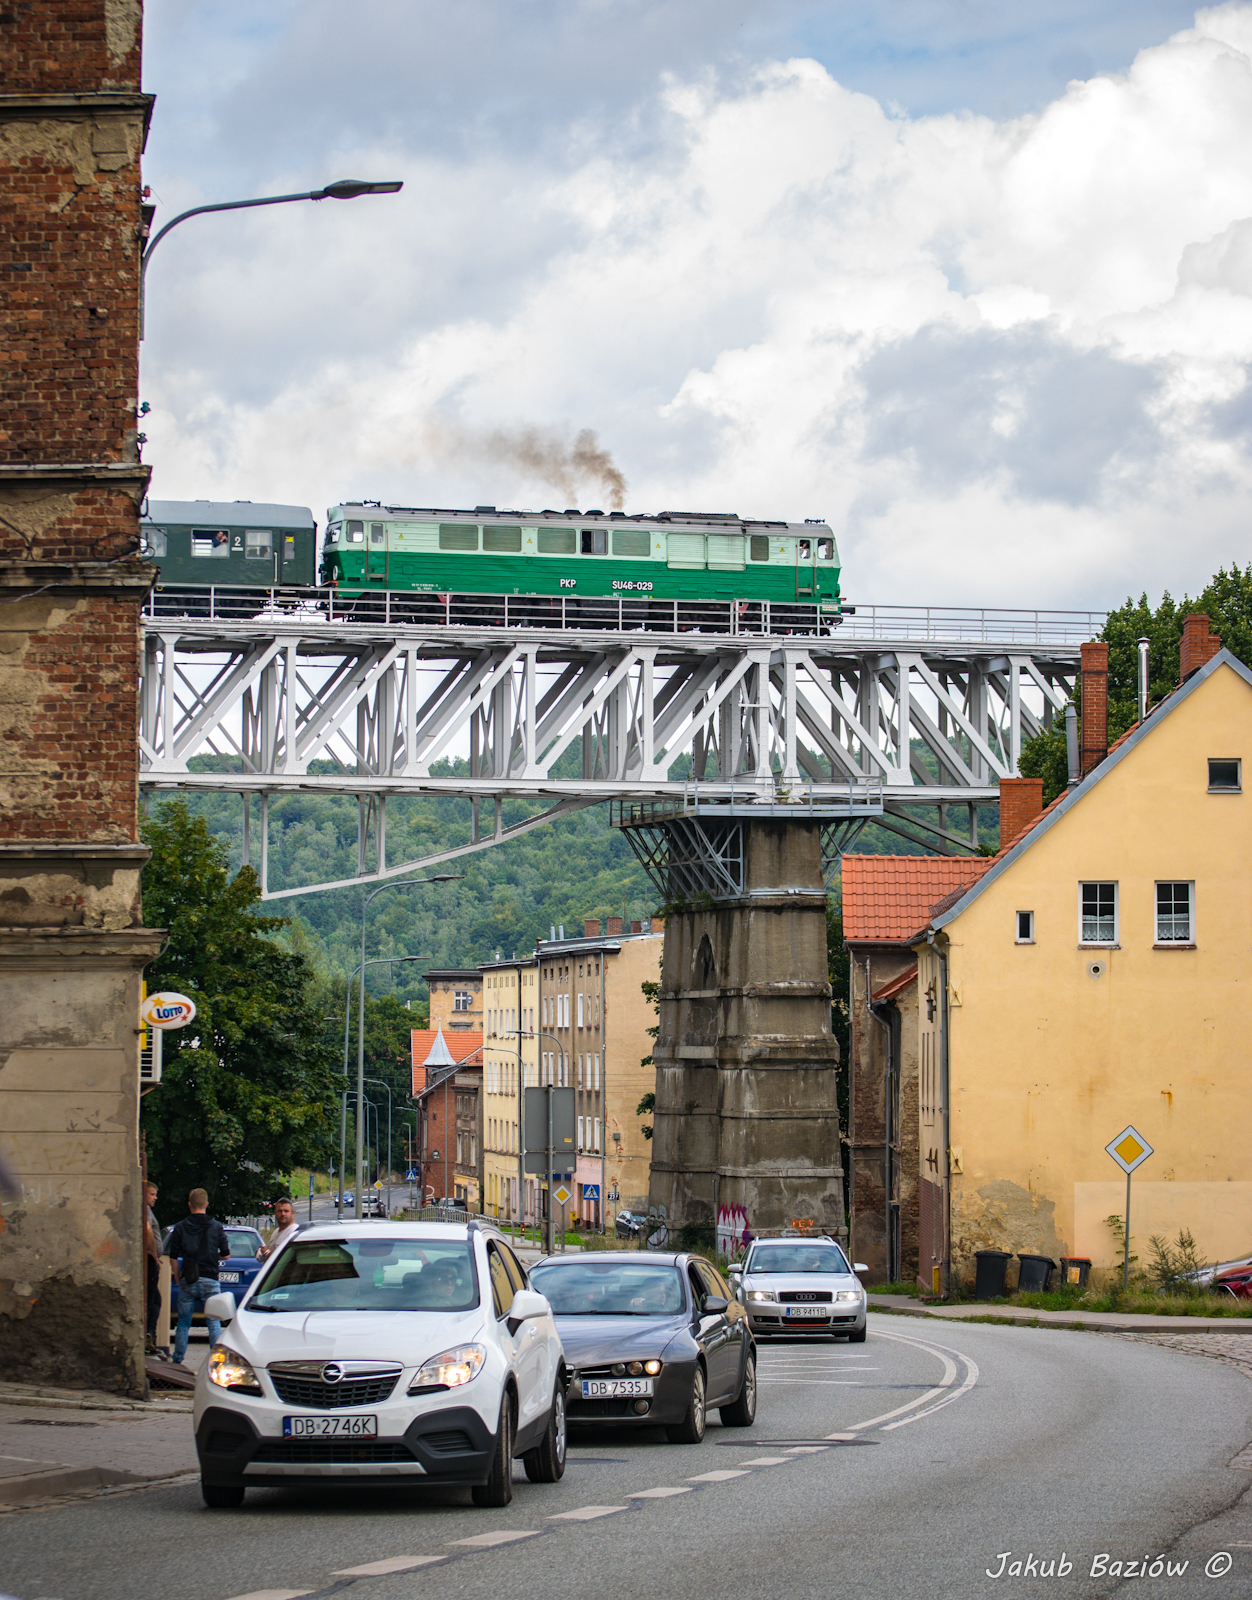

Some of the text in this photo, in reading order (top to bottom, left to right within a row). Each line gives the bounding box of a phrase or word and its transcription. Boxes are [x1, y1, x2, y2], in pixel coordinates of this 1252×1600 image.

[234, 536, 242, 547] 2
[560, 578, 577, 588] PKP
[612, 580, 653, 591] SU46-029
[156, 1006, 183, 1019] LOTTO
[791, 1308, 825, 1316] DB 9411E
[591, 1381, 648, 1395] DB 7535J
[294, 1417, 371, 1435] DB 2746K
